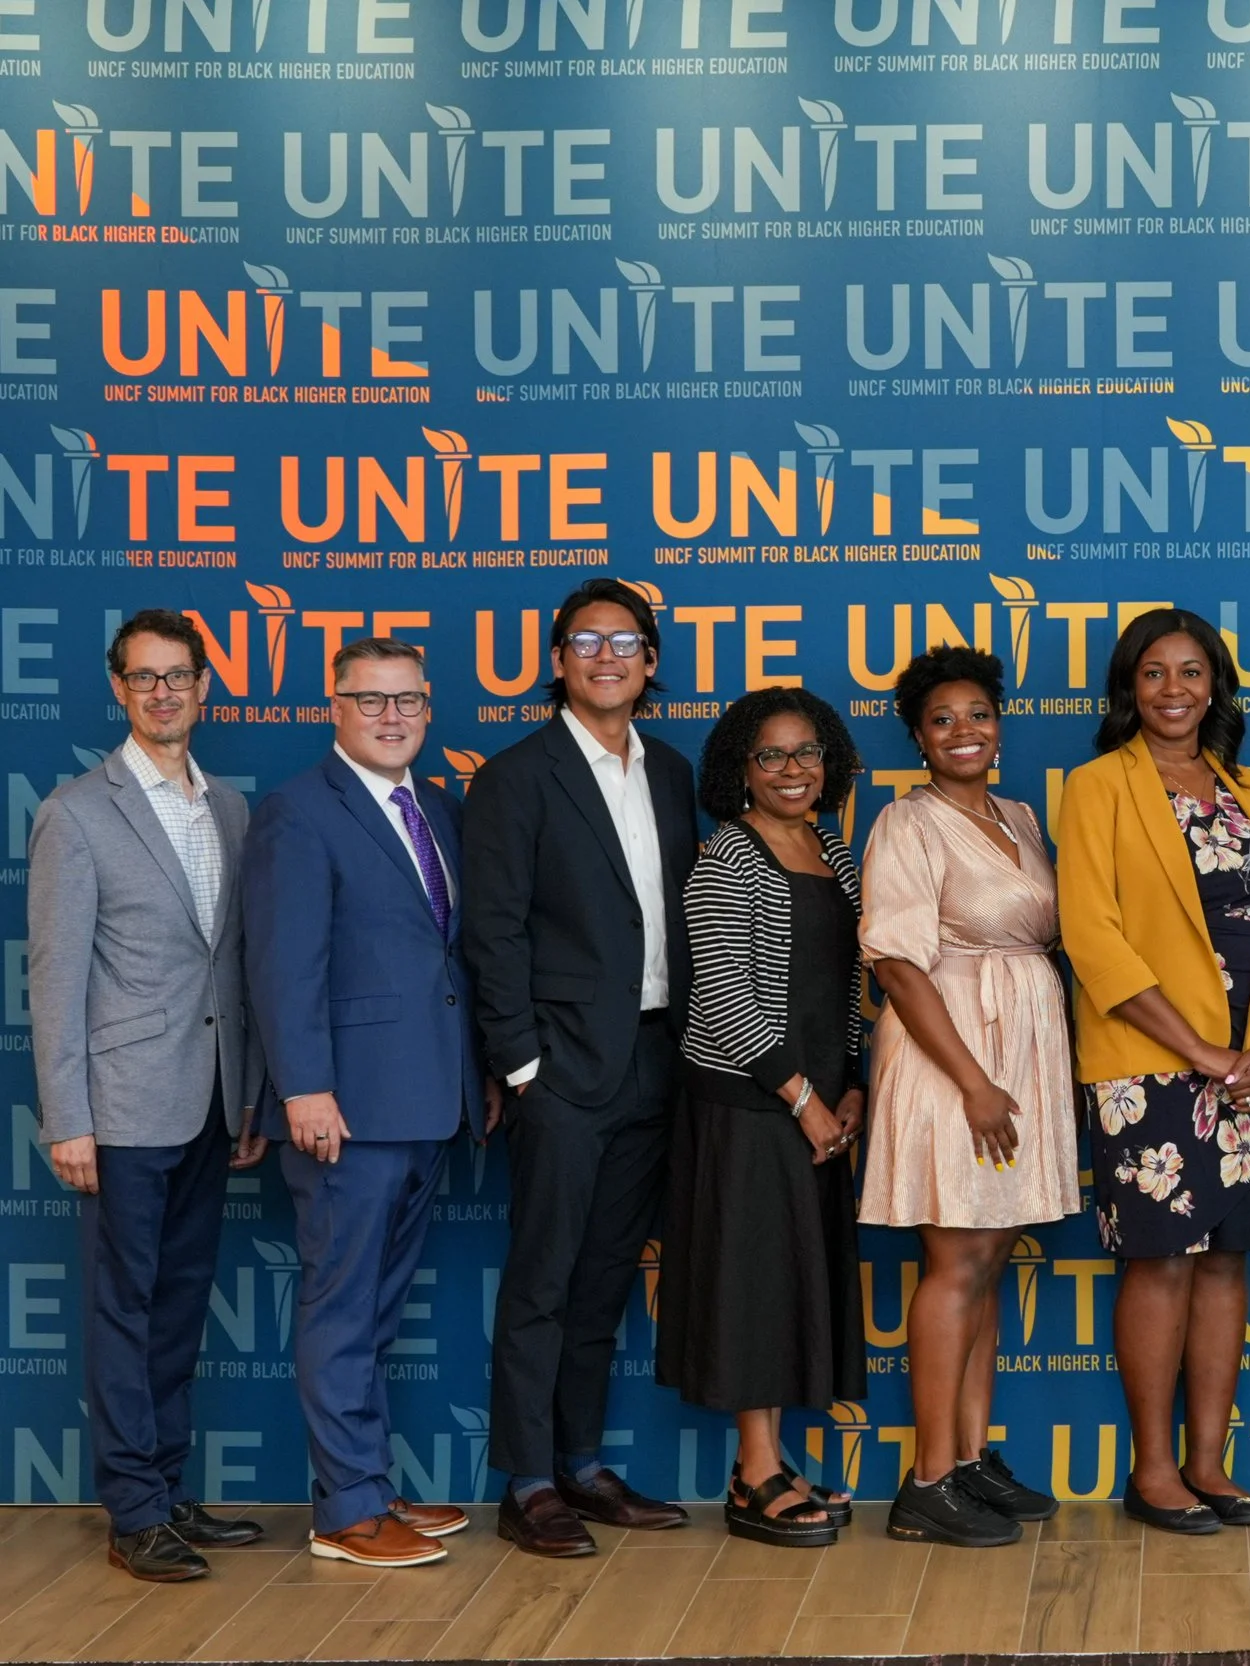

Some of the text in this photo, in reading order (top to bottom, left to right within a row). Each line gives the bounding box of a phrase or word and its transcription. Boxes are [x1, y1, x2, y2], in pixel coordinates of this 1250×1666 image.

[87, 60, 415, 80] UNCF SUMMIT FOR BLACK HIGHER EDUCATION
[833, 53, 1161, 73] UNCF SUMMIT FOR BLACK HIGHER EDUCATION
[284, 102, 610, 218] UNITE
[656, 95, 983, 213] UNITE
[285, 224, 612, 245] UNCF SUMMIT FOR BLACK HIGHER EDUCATION
[657, 219, 985, 240] UNCF SUMMIT FOR BLACK HIGHER EDUCATION
[1029, 218, 1068, 235] UNCF
[1072, 218, 1131, 235] SUMMIT
[1136, 217, 1164, 234] FOR
[1169, 217, 1215, 234] BLACK
[102, 260, 428, 377] UNITE
[474, 257, 800, 374] UNITE
[847, 252, 1173, 370] UNITE
[104, 384, 431, 404] UNCF SUMMIT FOR BLACK HIGHER EDUCATION
[476, 380, 802, 402] UNCF SUMMIT FOR BLACK HIGHER EDUCATION
[848, 377, 1175, 397] UNCF SUMMIT FOR BLACK HIGHER EDUCATION
[281, 426, 607, 542] UNITE
[653, 420, 979, 539] UNITE
[283, 549, 609, 569] UNCF SUMMIT FOR BLACK HIGHER EDUCATION
[654, 543, 981, 565] UNCF SUMMIT FOR BLACK HIGHER EDUCATION
[213, 706, 332, 723] FOR BLACK HIGH
[478, 706, 514, 722] UNCF
[668, 702, 720, 719] HIGHER
[850, 700, 887, 717] UNCF
[1041, 698, 1092, 715] HIGHER
[44, 1200, 72, 1217] FOR
[448, 1204, 493, 1221] BLACK
[219, 1361, 247, 1378] FOR
[997, 1354, 1100, 1373] BLACK HIGHER
